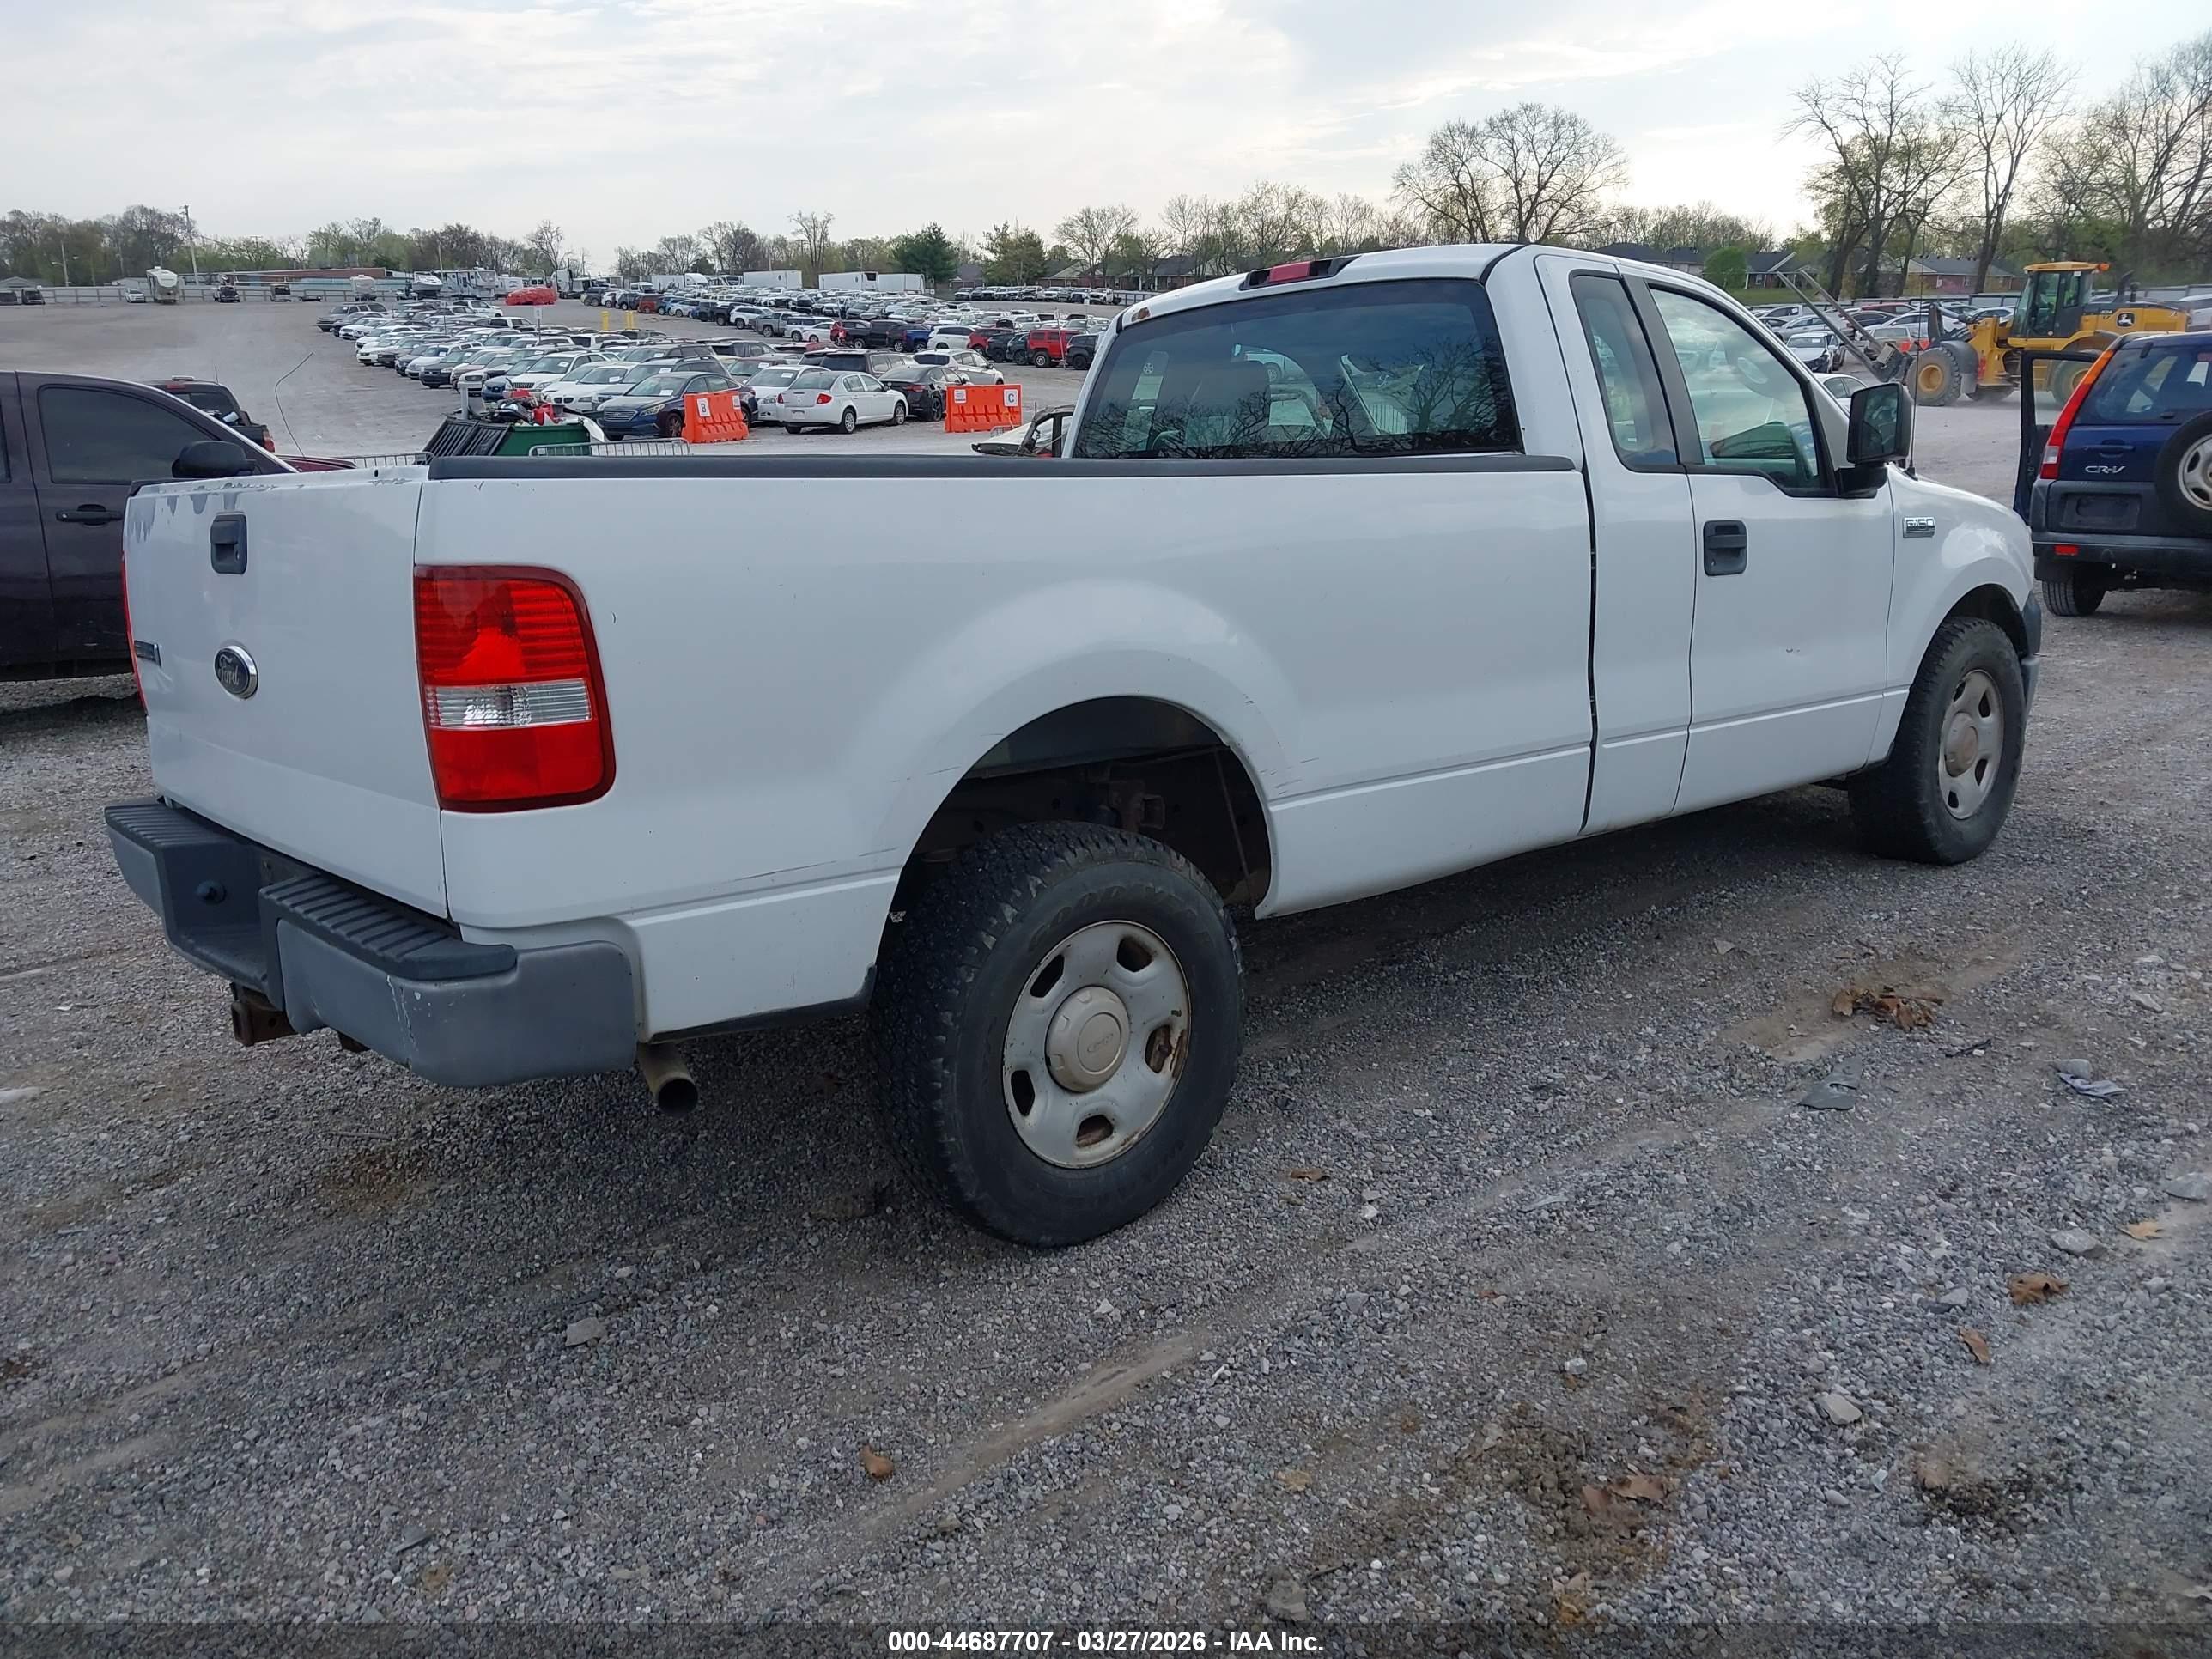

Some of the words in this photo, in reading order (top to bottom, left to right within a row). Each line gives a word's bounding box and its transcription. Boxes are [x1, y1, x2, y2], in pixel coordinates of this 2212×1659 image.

[1008, 393, 1015, 403] C
[701, 403, 707, 413] B
[2085, 465, 2126, 474] CR-V
